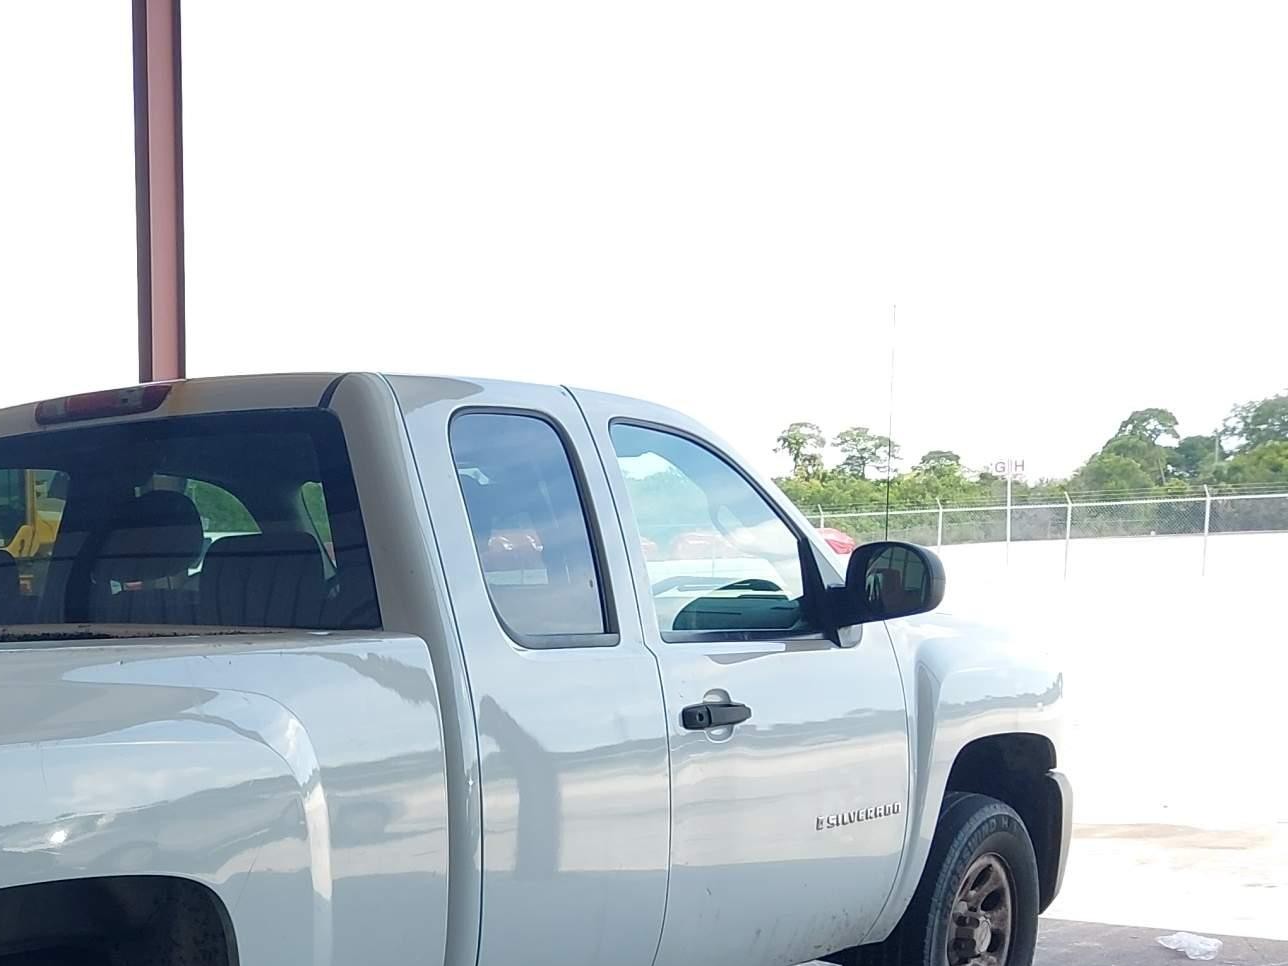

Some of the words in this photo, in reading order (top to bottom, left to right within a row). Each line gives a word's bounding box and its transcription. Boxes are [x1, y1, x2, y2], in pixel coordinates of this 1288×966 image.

[994, 461, 1006, 473] G
[1014, 459, 1025, 472] H
[826, 802, 902, 829] SILVERADO
